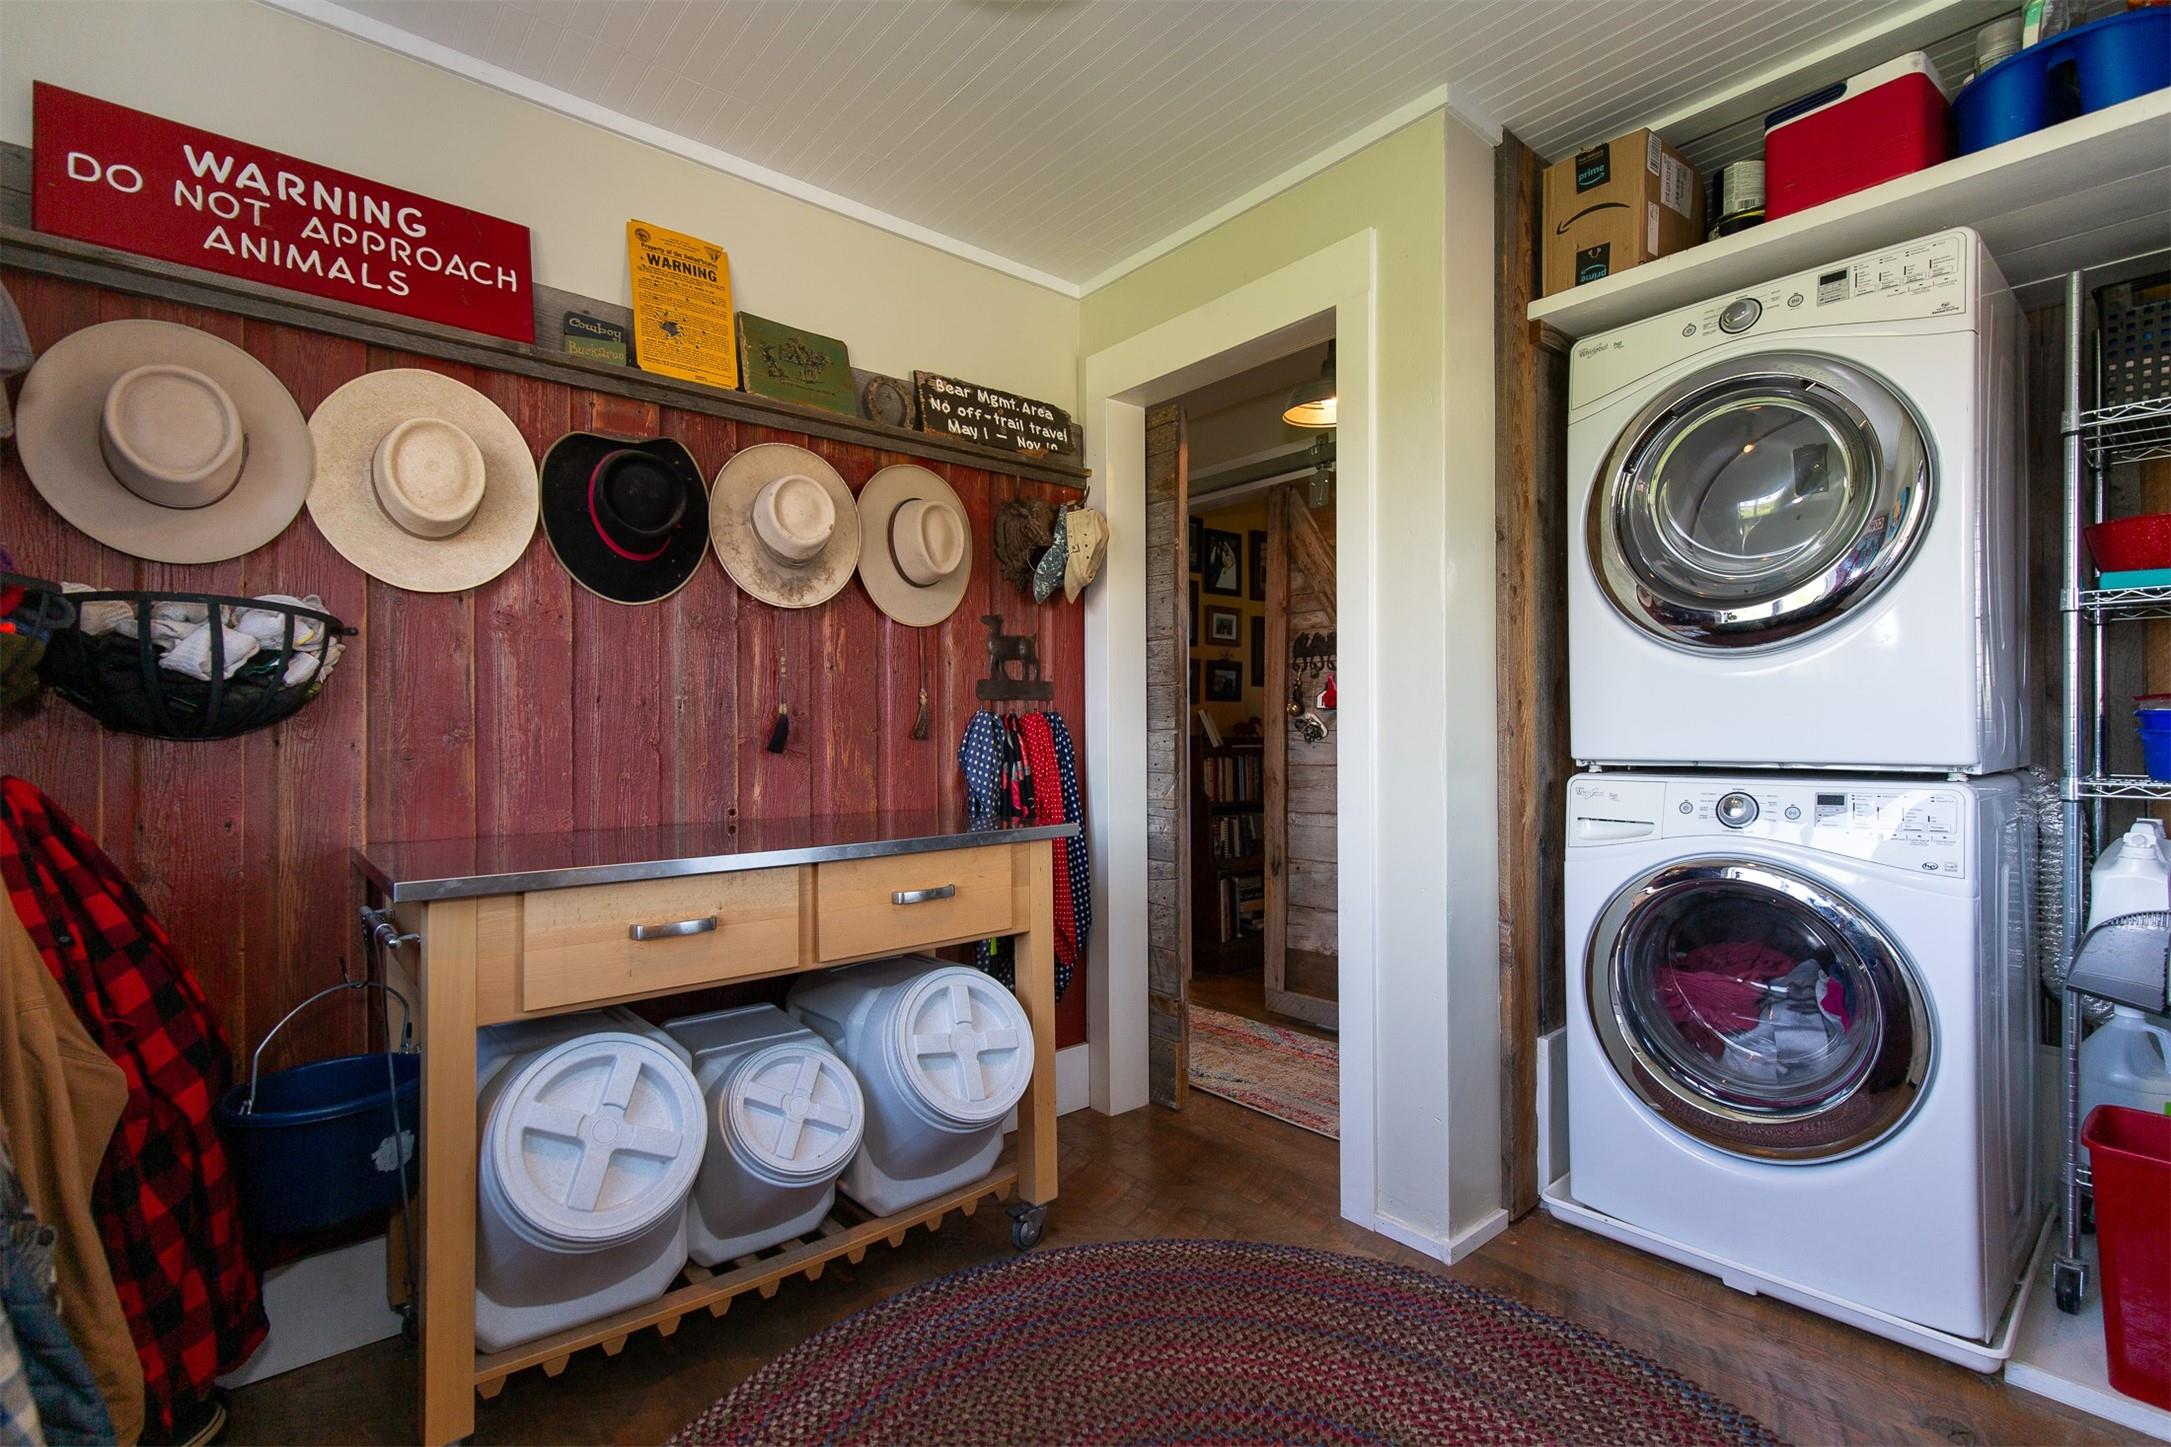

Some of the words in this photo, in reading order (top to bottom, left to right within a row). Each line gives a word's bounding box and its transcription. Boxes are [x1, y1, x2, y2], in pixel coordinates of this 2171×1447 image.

[1579, 164, 1605, 182] prime
[183, 144, 427, 238] WARNING
[67, 151, 143, 194] DO
[174, 179, 271, 227] NOT
[301, 217, 518, 292] APPROACH
[203, 225, 410, 297] ANIMALS
[640, 241, 665, 255] Property
[646, 252, 717, 283] WARNING
[1580, 267, 1607, 283] prime
[569, 317, 622, 343] Cowboy
[935, 379, 971, 399] Bear
[977, 388, 1020, 412] Mgmt.
[1022, 402, 1054, 421] Area
[929, 396, 951, 414] No
[957, 405, 1024, 432] off-trail
[1029, 421, 1068, 443] travel
[948, 418, 979, 440] May
[1016, 435, 1041, 450] Nov
